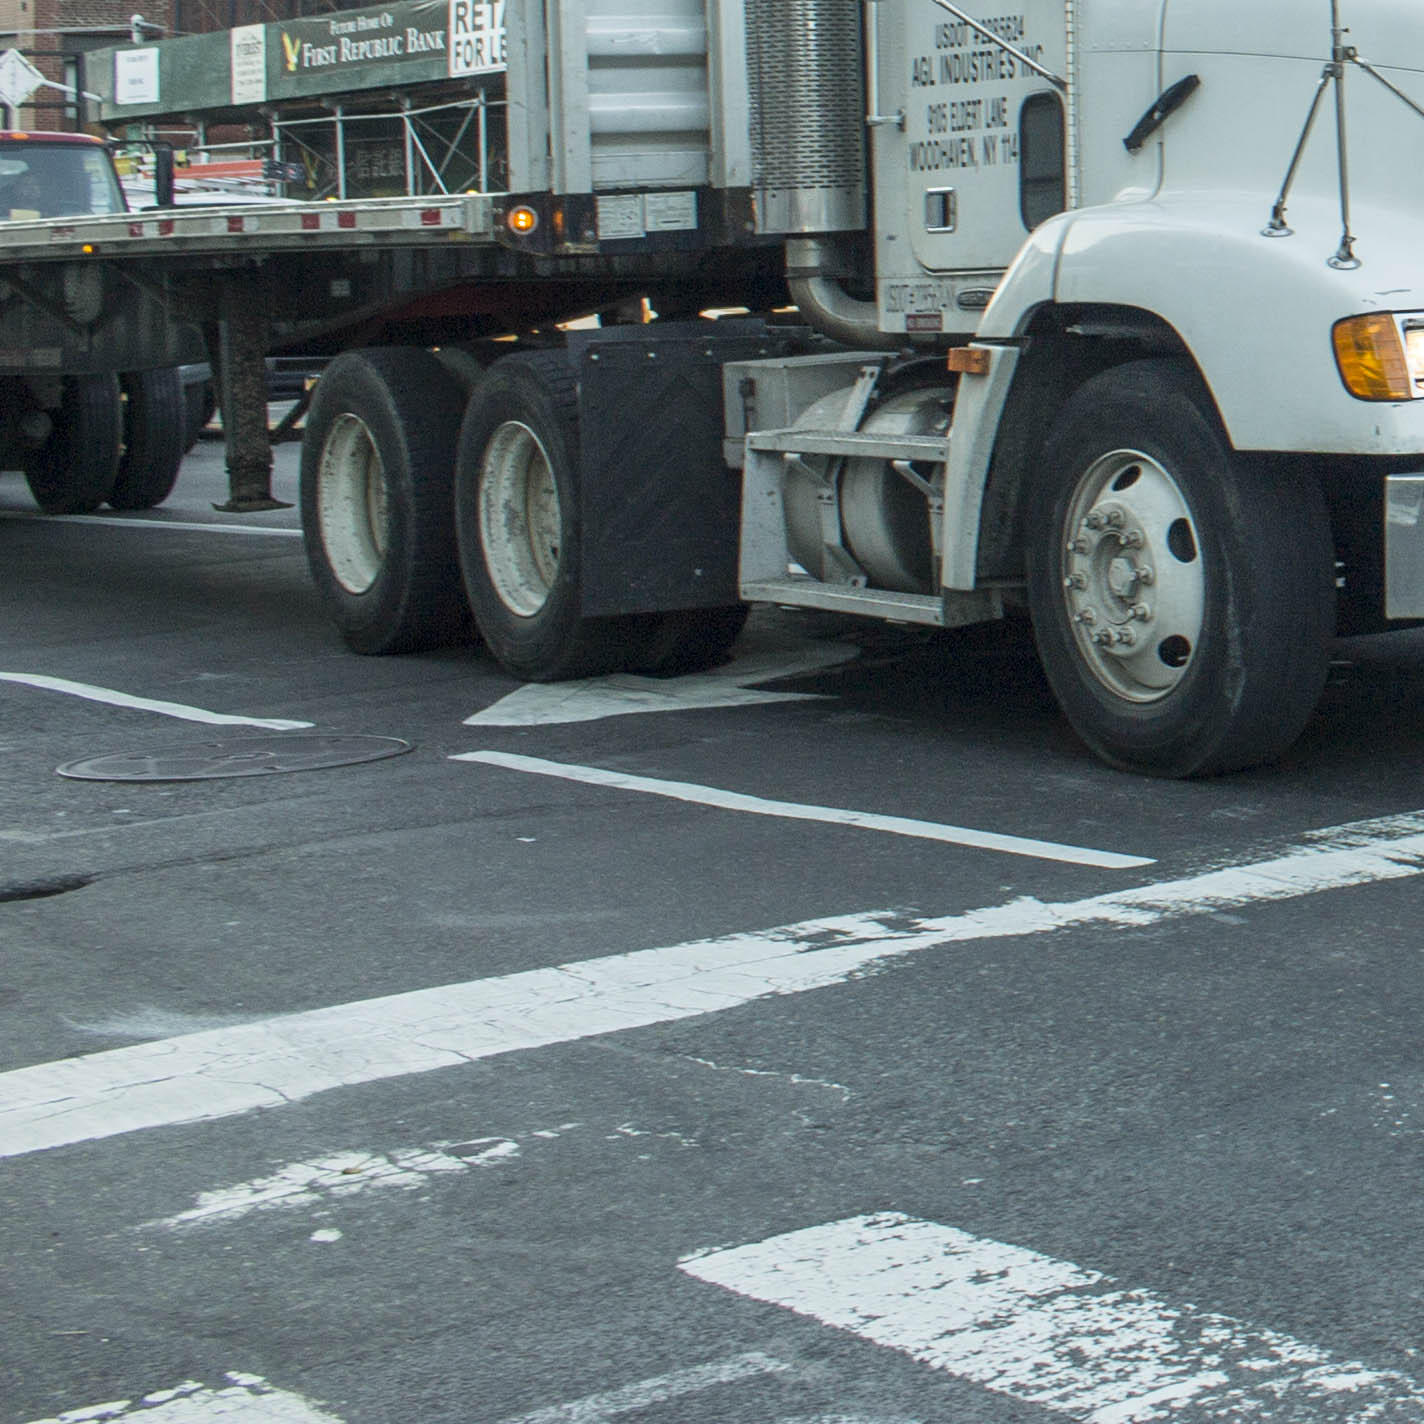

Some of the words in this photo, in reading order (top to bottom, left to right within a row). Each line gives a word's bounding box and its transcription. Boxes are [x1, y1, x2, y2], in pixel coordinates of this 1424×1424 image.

[455, 37, 485, 70] FOR
[911, 55, 936, 87] AGL
[939, 49, 1016, 85] INDUSTRIES
[983, 134, 998, 166] NY
